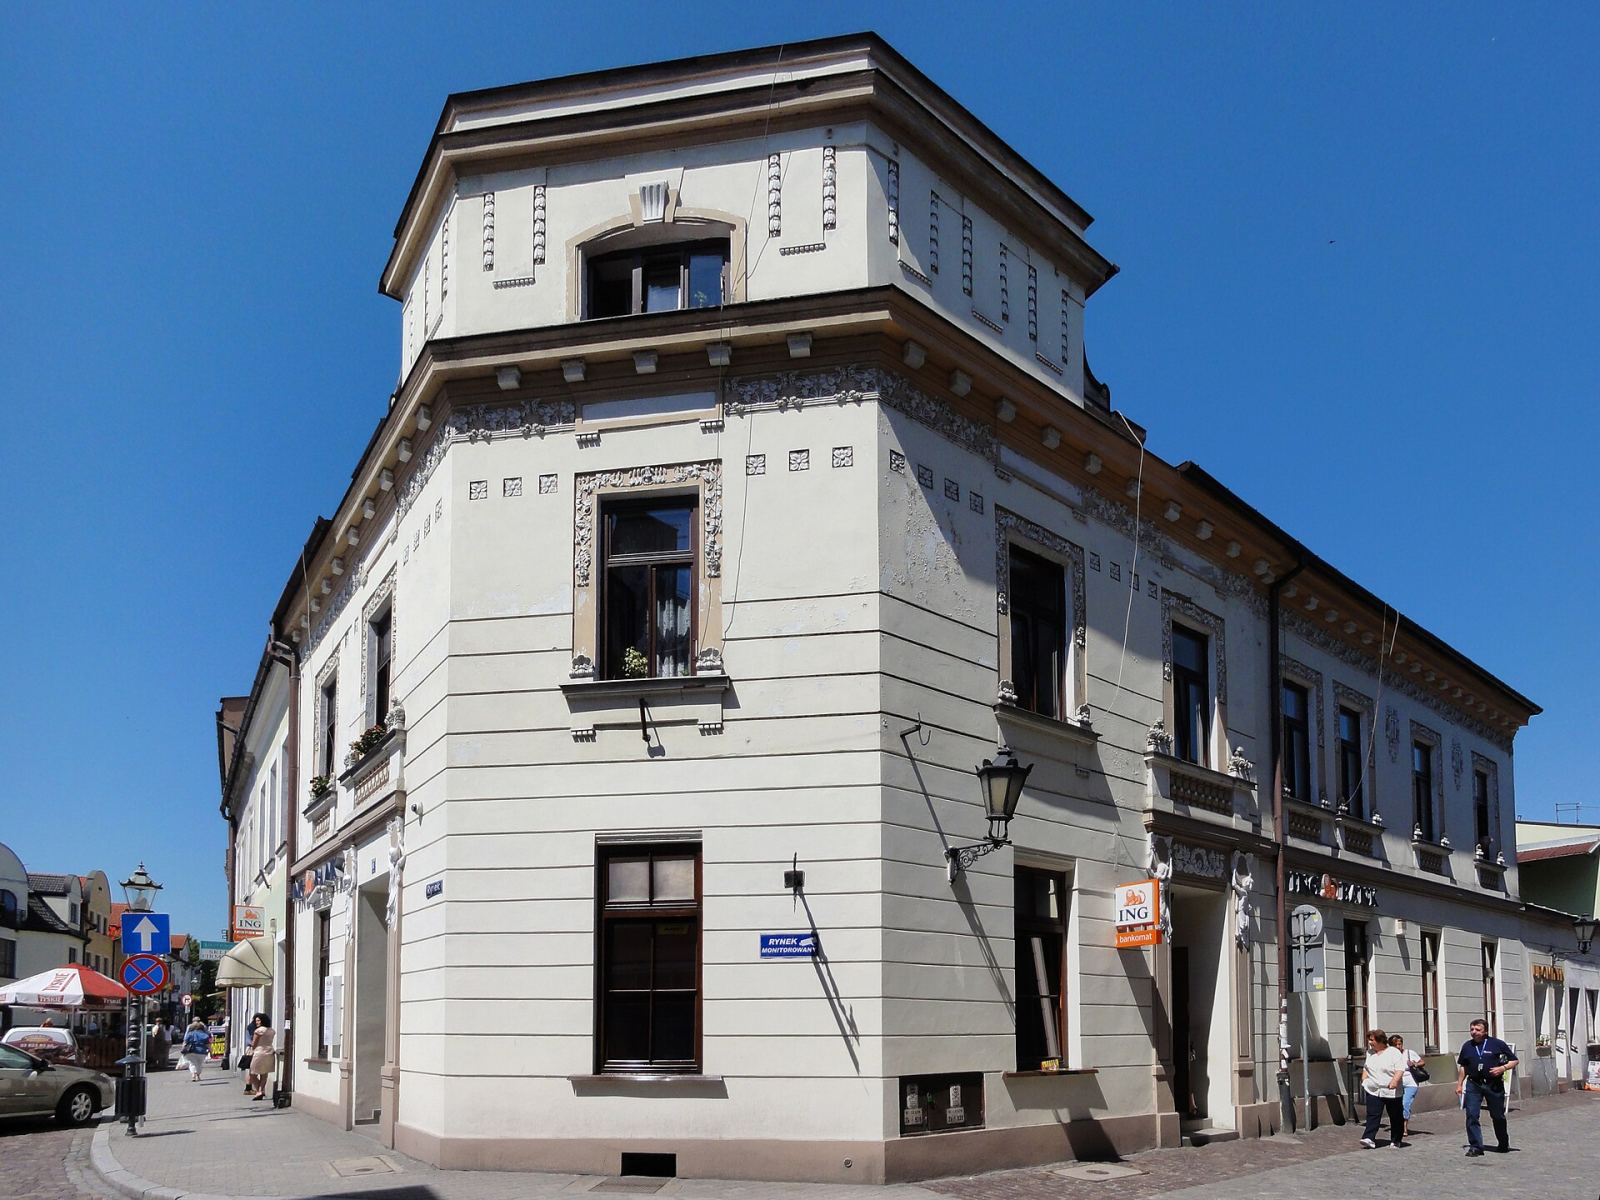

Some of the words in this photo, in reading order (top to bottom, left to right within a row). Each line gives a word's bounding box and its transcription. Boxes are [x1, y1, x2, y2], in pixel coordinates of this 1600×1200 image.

[1119, 906, 1149, 922] ING
[239, 919, 261, 928] ING
[768, 938, 798, 946] RYNEK
[1119, 933, 1153, 943] bankomat
